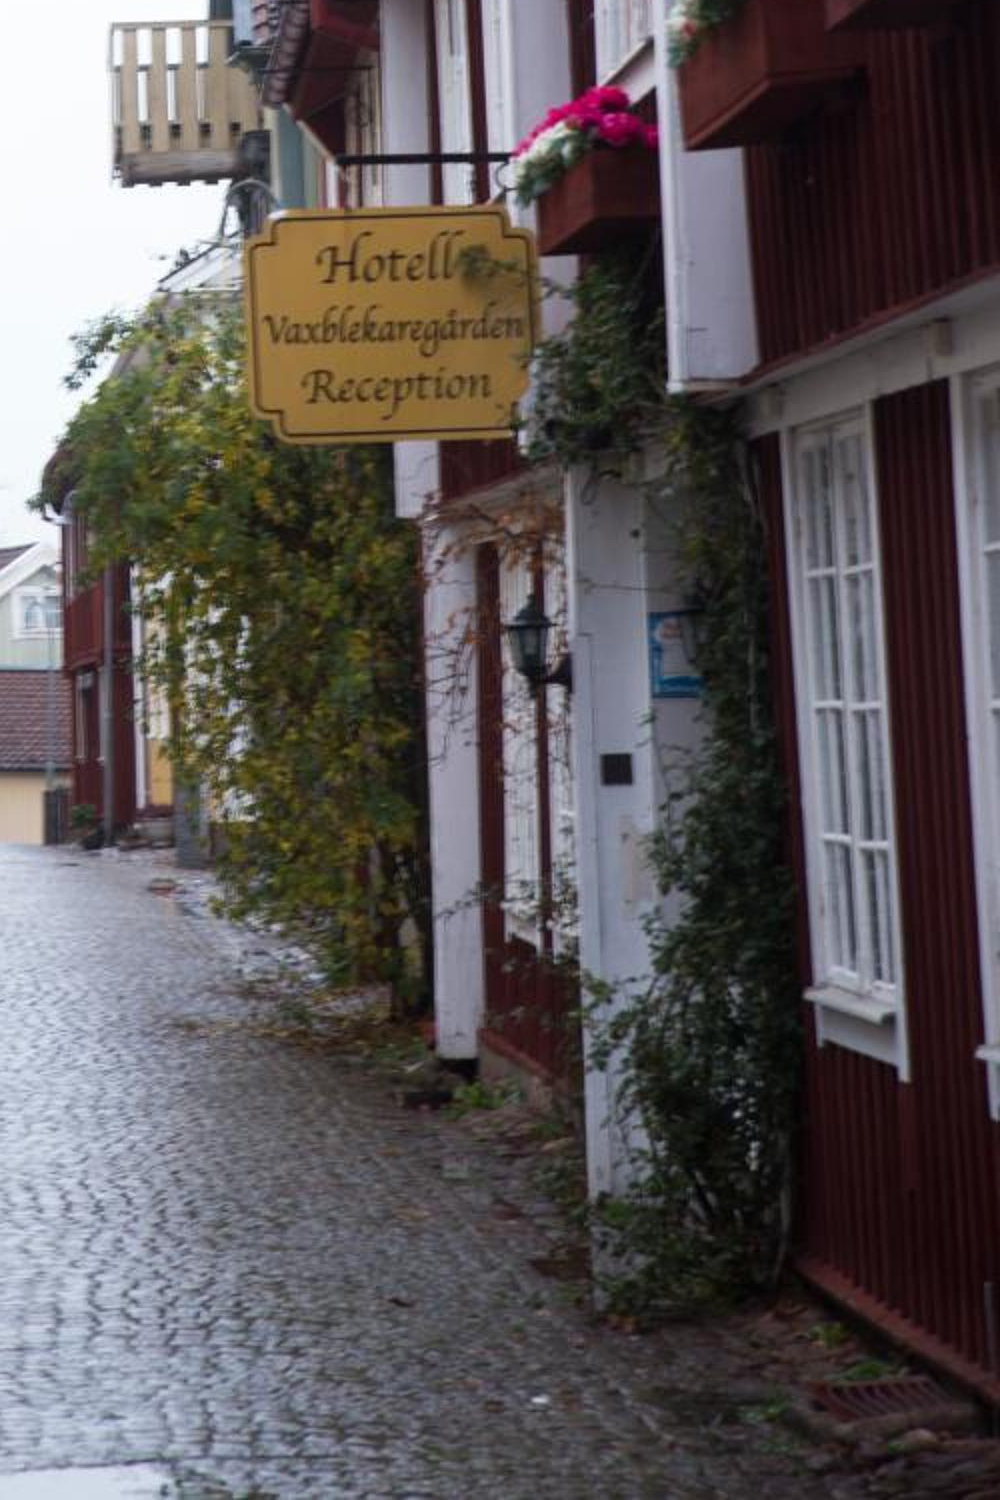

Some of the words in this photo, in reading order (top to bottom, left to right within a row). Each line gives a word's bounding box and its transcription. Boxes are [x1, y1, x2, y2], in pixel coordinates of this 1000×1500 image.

[315, 229, 464, 284] Hotell
[262, 301, 525, 357] Vaxblekaregården
[301, 366, 492, 421] Reception
